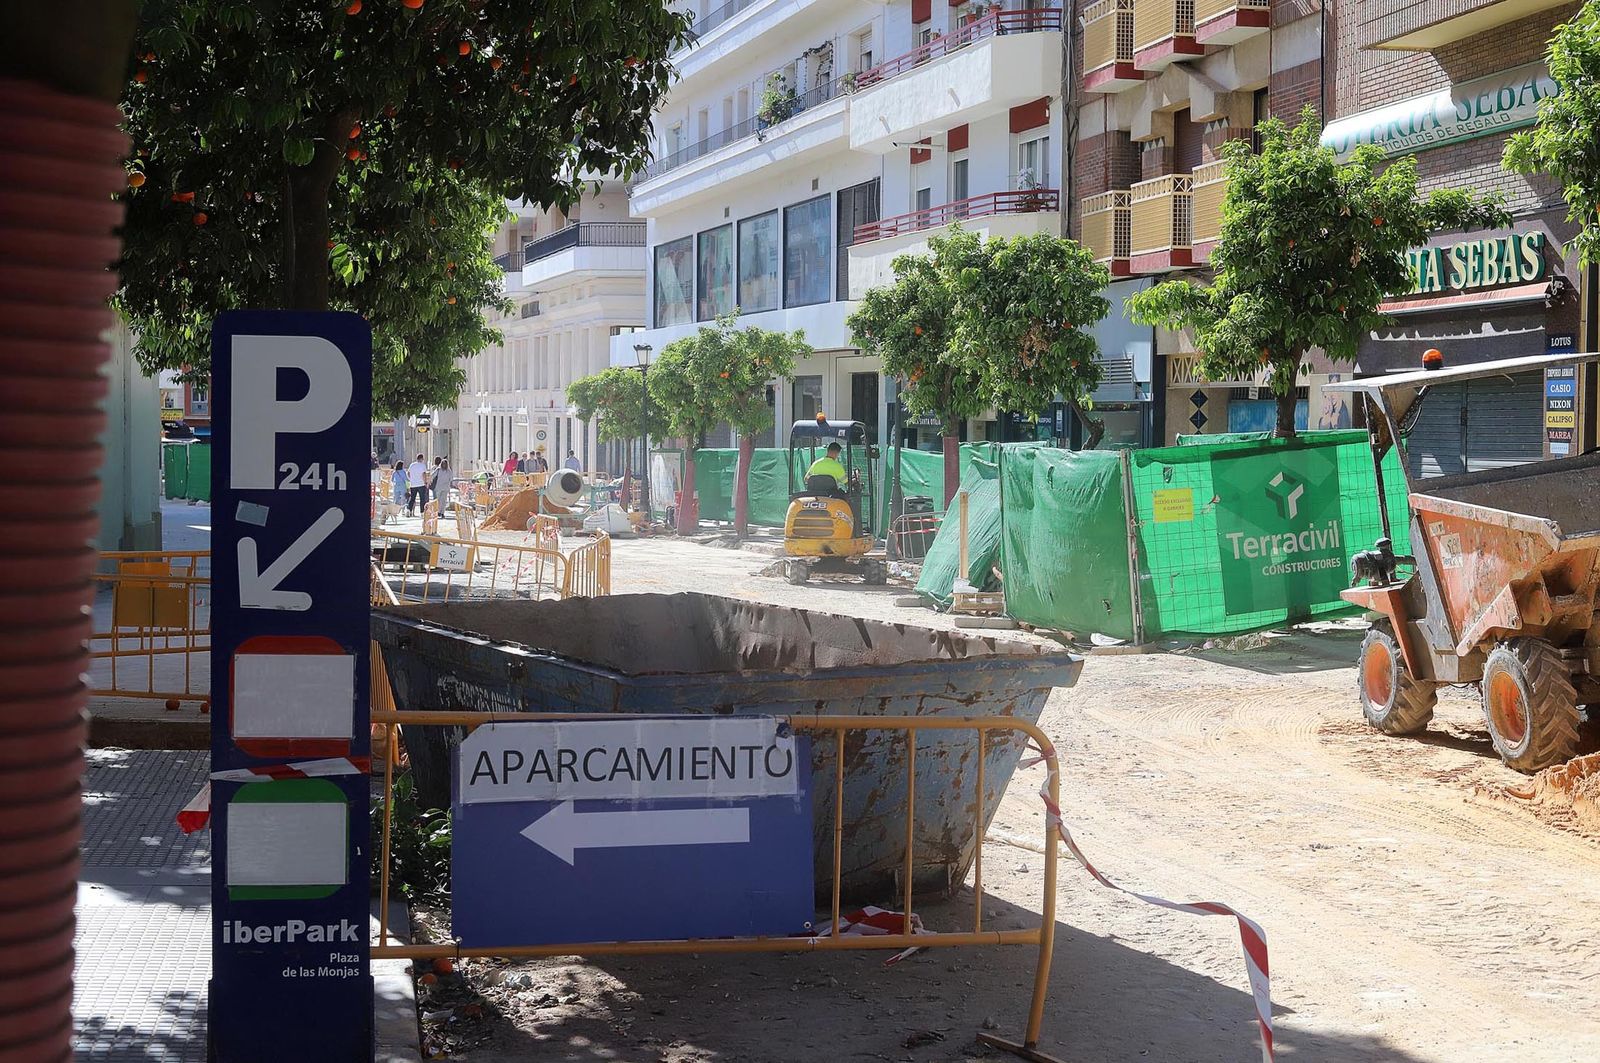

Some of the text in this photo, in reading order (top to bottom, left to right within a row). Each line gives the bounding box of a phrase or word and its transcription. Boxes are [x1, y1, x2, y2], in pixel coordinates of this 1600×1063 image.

[1436, 126, 1455, 139] DE
[1456, 113, 1511, 132] REGALO
[1450, 231, 1545, 290] SEBAS
[1551, 336, 1571, 347] LOTUS
[1550, 384, 1571, 393] CASIO
[1550, 400, 1571, 409] NIXON
[230, 334, 353, 490] P
[1548, 415, 1573, 424] CALIPSO
[1548, 431, 1571, 440] MAREA
[1226, 520, 1340, 560] Terracivil
[440, 557, 465, 566] Terracivil
[1262, 557, 1341, 576] CONSTRUCTORES
[469, 745, 793, 786] APARCAMIENTO
[222, 919, 360, 944] iberPark
[330, 953, 360, 963] Plaza
[282, 966, 360, 979] de las Monjas
